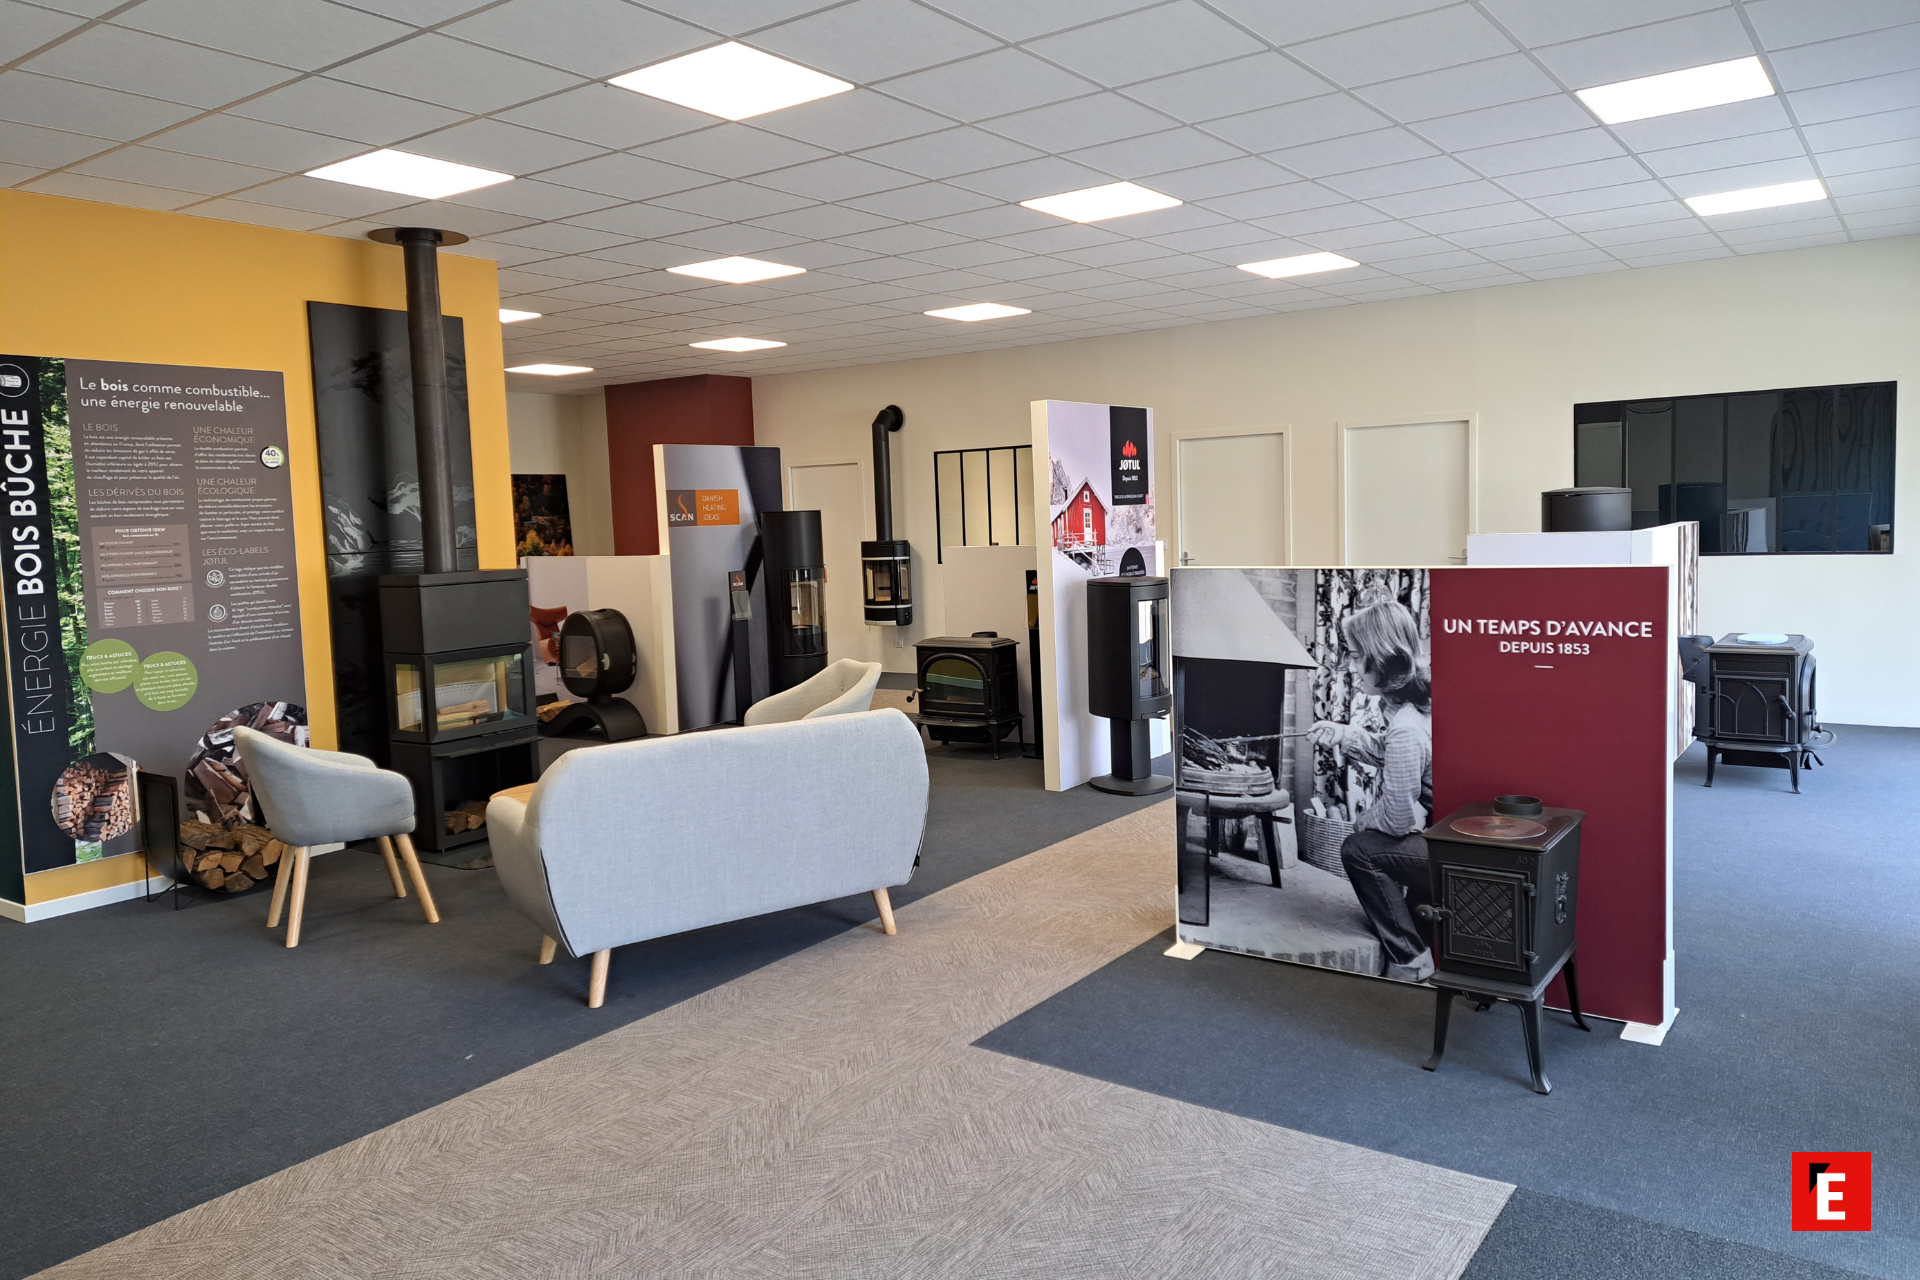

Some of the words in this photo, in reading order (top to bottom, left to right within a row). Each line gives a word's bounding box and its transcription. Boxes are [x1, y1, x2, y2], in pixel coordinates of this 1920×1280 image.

[79, 377, 97, 391] Le
[100, 378, 129, 392] bois
[132, 382, 182, 394] comme
[185, 384, 270, 399] combustible...
[81, 398, 109, 407] une
[110, 395, 160, 413] énergie
[164, 399, 243, 412] renouvelable
[82, 423, 93, 431] LE
[95, 423, 118, 431] BOIS
[193, 426, 212, 434] UNE
[213, 427, 253, 435] CHALEUR
[194, 434, 255, 444] ÉCONOMIQUE
[0, 409, 37, 517] BÛCHE
[1119, 459, 1141, 471] JØTUL
[196, 478, 216, 486] UNE
[216, 478, 257, 486] CHALEUR
[88, 488, 105, 497] LES
[106, 487, 146, 496] DÉRIVÉS
[147, 488, 161, 496] DU
[163, 488, 184, 496] BOIS
[197, 486, 255, 496] ÉCOLOGIQUE
[670, 513, 694, 522] SCAN
[703, 513, 720, 521] IDEAS
[202, 549, 217, 557] LES
[218, 546, 269, 556] ÉCO-LABELS
[13, 525, 44, 596] BOIS
[202, 557, 229, 566] JØTUL
[1443, 619, 1472, 634] UN
[1477, 619, 1541, 636] TEMPS
[1546, 620, 1653, 638] D’AVANCE
[1500, 641, 1555, 654] DEPUIS
[1558, 643, 1590, 655] 1853
[18, 604, 55, 735] ÉNERGIE
